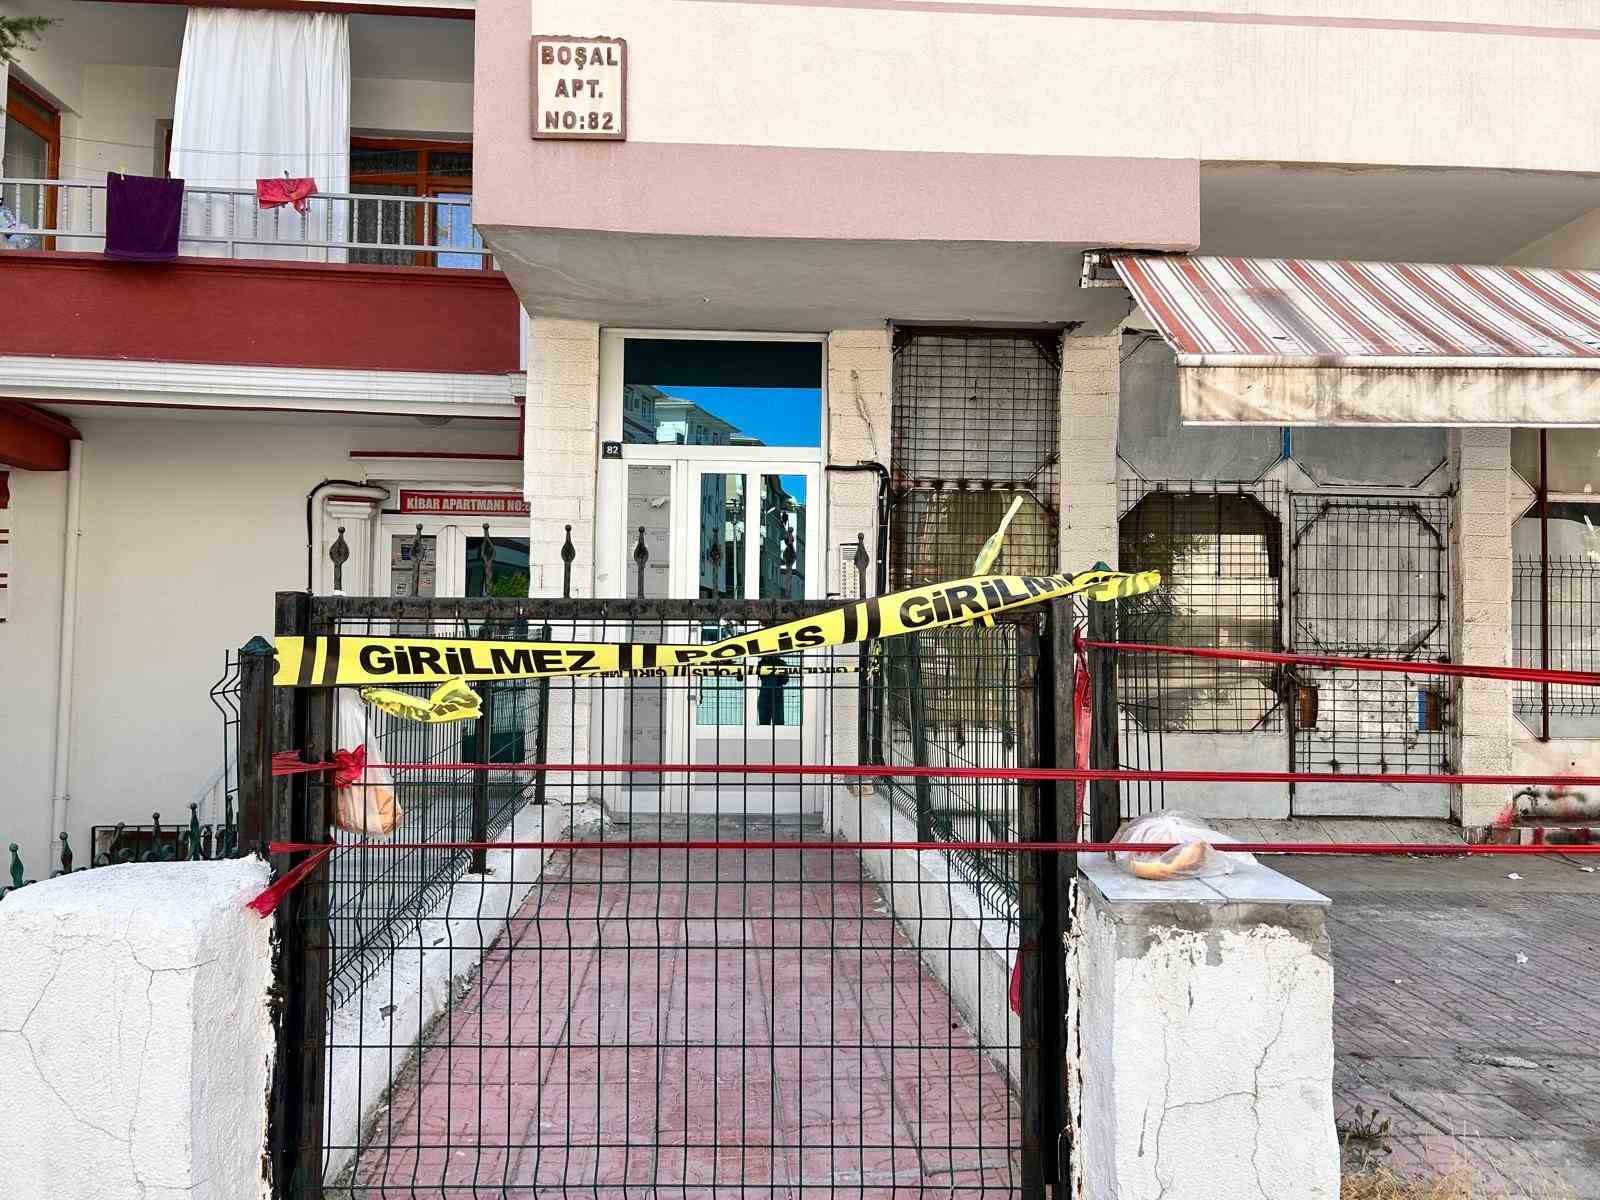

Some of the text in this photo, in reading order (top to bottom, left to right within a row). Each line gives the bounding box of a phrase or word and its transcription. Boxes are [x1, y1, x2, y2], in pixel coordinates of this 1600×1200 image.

[541, 45, 619, 70] BOŞAL
[554, 78, 604, 98] APT.
[545, 110, 614, 130] NO:82
[607, 445, 619, 455] 82
[406, 496, 441, 511] KİBAR
[442, 498, 505, 512] APARTMANI
